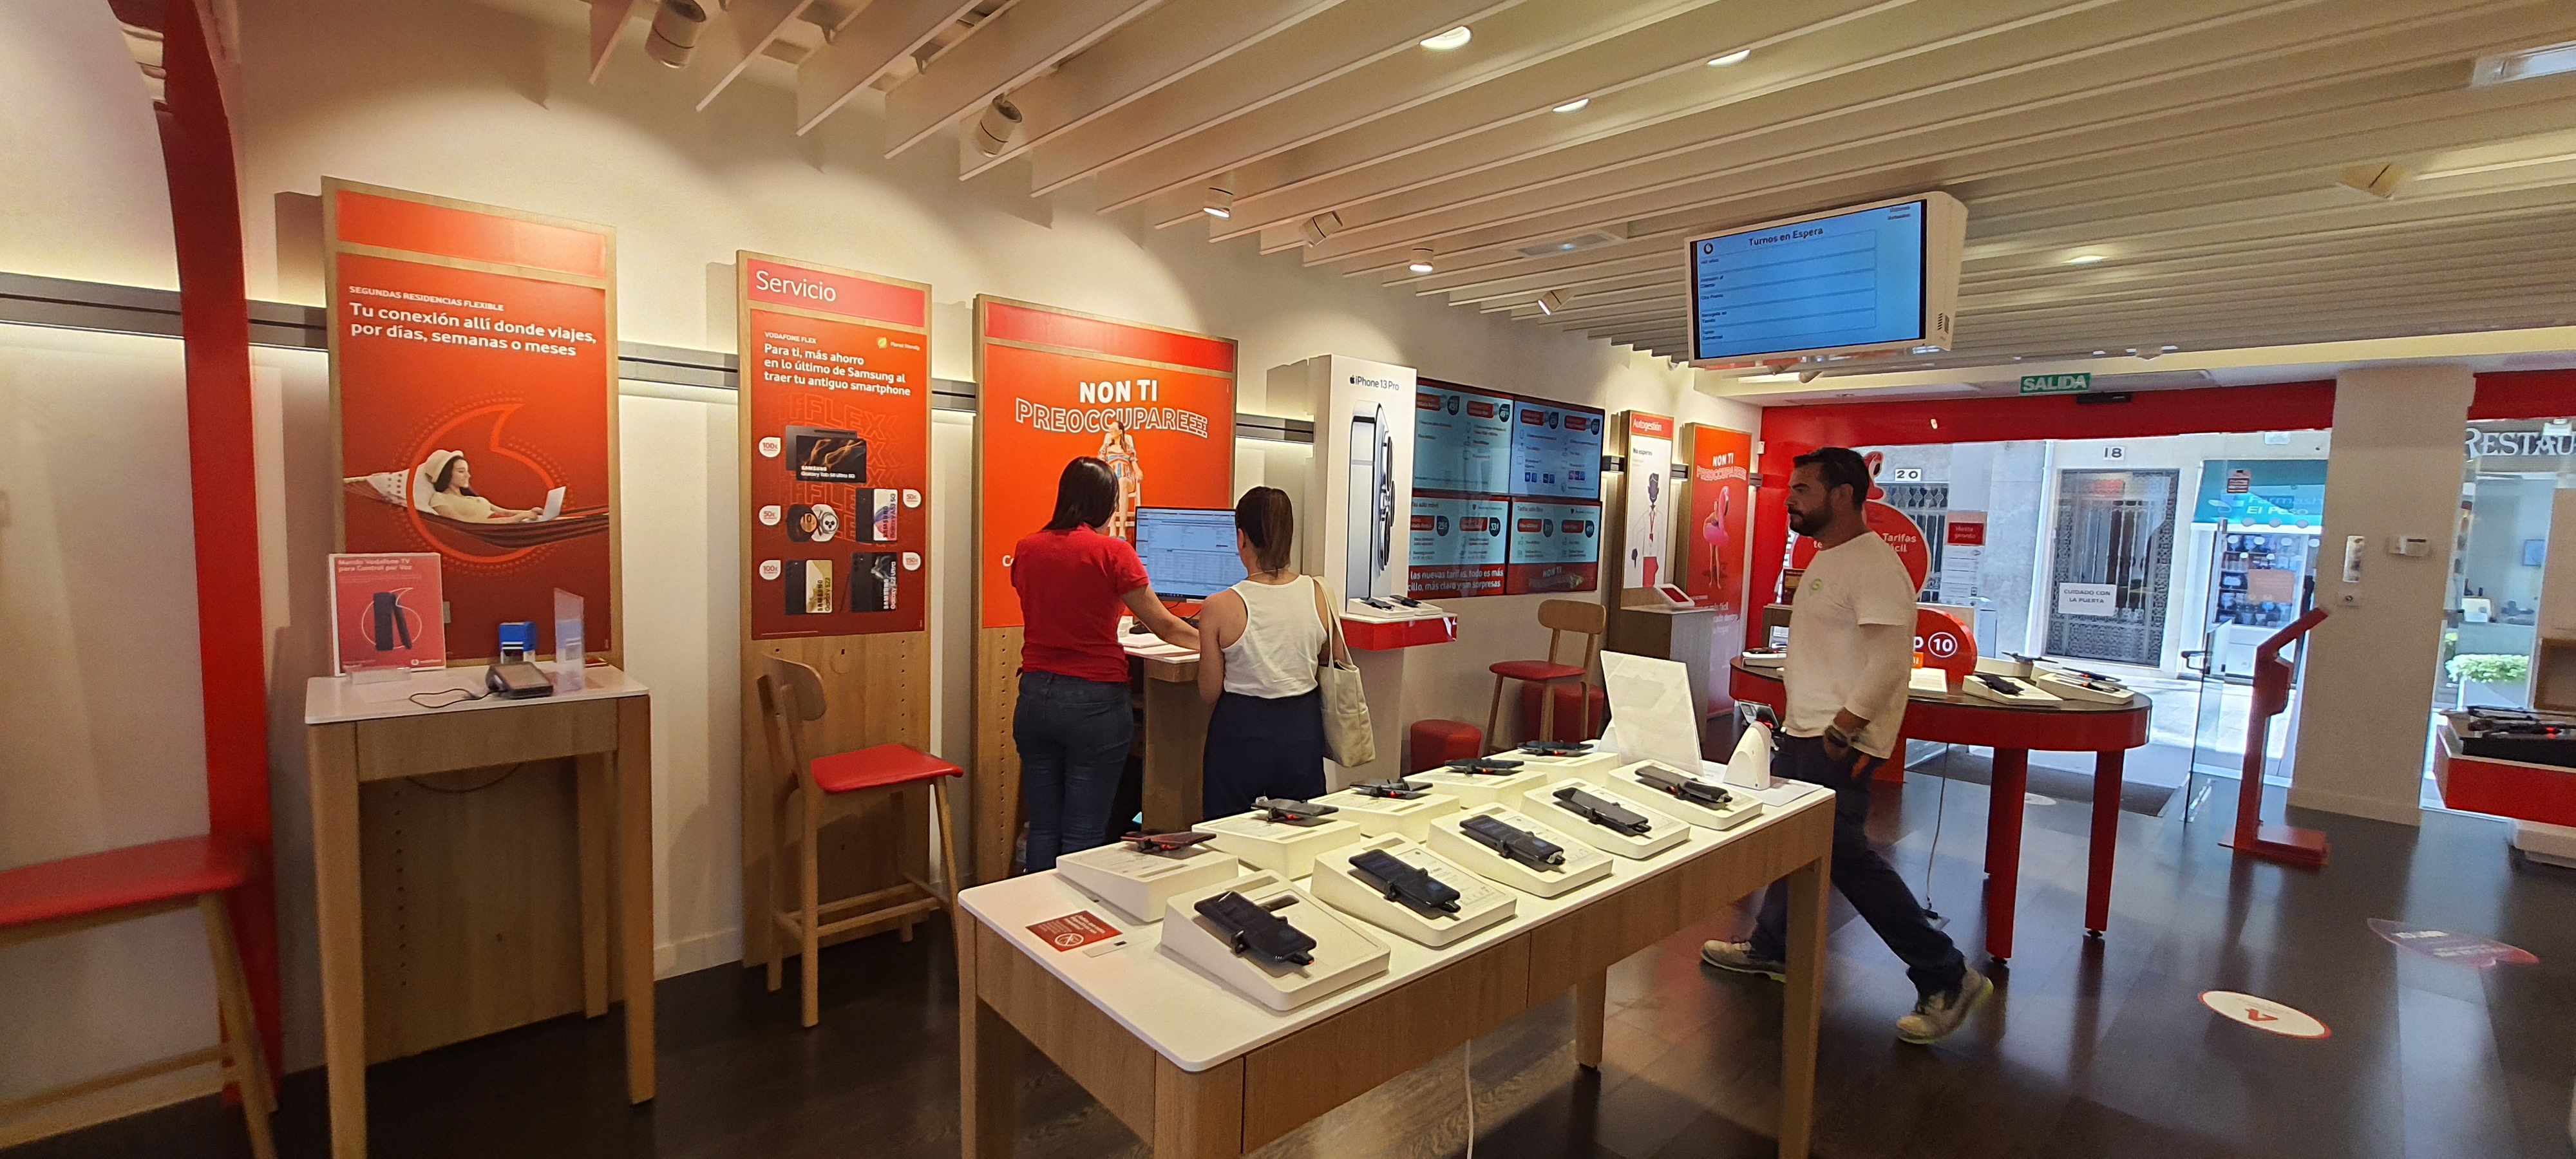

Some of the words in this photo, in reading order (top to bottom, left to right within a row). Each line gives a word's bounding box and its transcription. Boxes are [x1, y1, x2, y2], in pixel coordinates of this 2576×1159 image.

[1749, 236, 1777, 246] Turnos
[1793, 227, 1824, 240] Espera
[756, 270, 837, 302] Servicio
[349, 286, 401, 299] SEGUNDAS
[402, 292, 462, 306] RESIDENCIAS
[464, 299, 504, 312] FLEXIBLE
[349, 302, 374, 317] Tu
[378, 308, 459, 327] conexión
[464, 316, 491, 330] allí
[494, 319, 545, 337] donde
[547, 326, 596, 344] viajes,
[351, 323, 383, 337] por
[386, 325, 428, 342] días,
[431, 331, 507, 349] semanas
[511, 340, 521, 350] o
[525, 342, 576, 356] meses
[764, 331, 800, 342] VODAFONE
[764, 343, 789, 356] Para
[791, 347, 802, 359] ti,
[805, 350, 828, 361] más
[829, 352, 864, 365] ahorro
[764, 359, 779, 368] en
[781, 359, 792, 369] lo
[795, 360, 830, 374] último
[832, 365, 846, 375] de
[848, 366, 894, 384] Samsung
[896, 373, 906, 383] al
[764, 371, 792, 383] traer
[793, 374, 806, 384] tu
[808, 377, 849, 390] antiguo
[851, 382, 911, 396] smartphone
[1355, 375, 1379, 388] iPhone
[1380, 379, 1387, 389] 13
[1388, 381, 1399, 391] Pro
[2023, 375, 2087, 391] SALIDA
[1079, 380, 1131, 404] NON
[1137, 379, 1157, 402] TI
[1633, 419, 1662, 432] Autogestión
[1712, 453, 1727, 467] NON
[1728, 452, 1734, 464] TI
[2105, 448, 2122, 458] 18
[1897, 470, 1918, 479] 20
[2268, 506, 2309, 514] Peso
[1882, 532, 1917, 543] Tarifas
[1410, 570, 1421, 580] las
[1421, 571, 1445, 580] nuevas
[1469, 569, 1482, 578] todo
[1492, 567, 1504, 577] más
[1425, 581, 1439, 590] más
[1440, 581, 1456, 590] claro
[1472, 580, 1501, 590] sorpresas
[1933, 638, 1953, 652] 10
